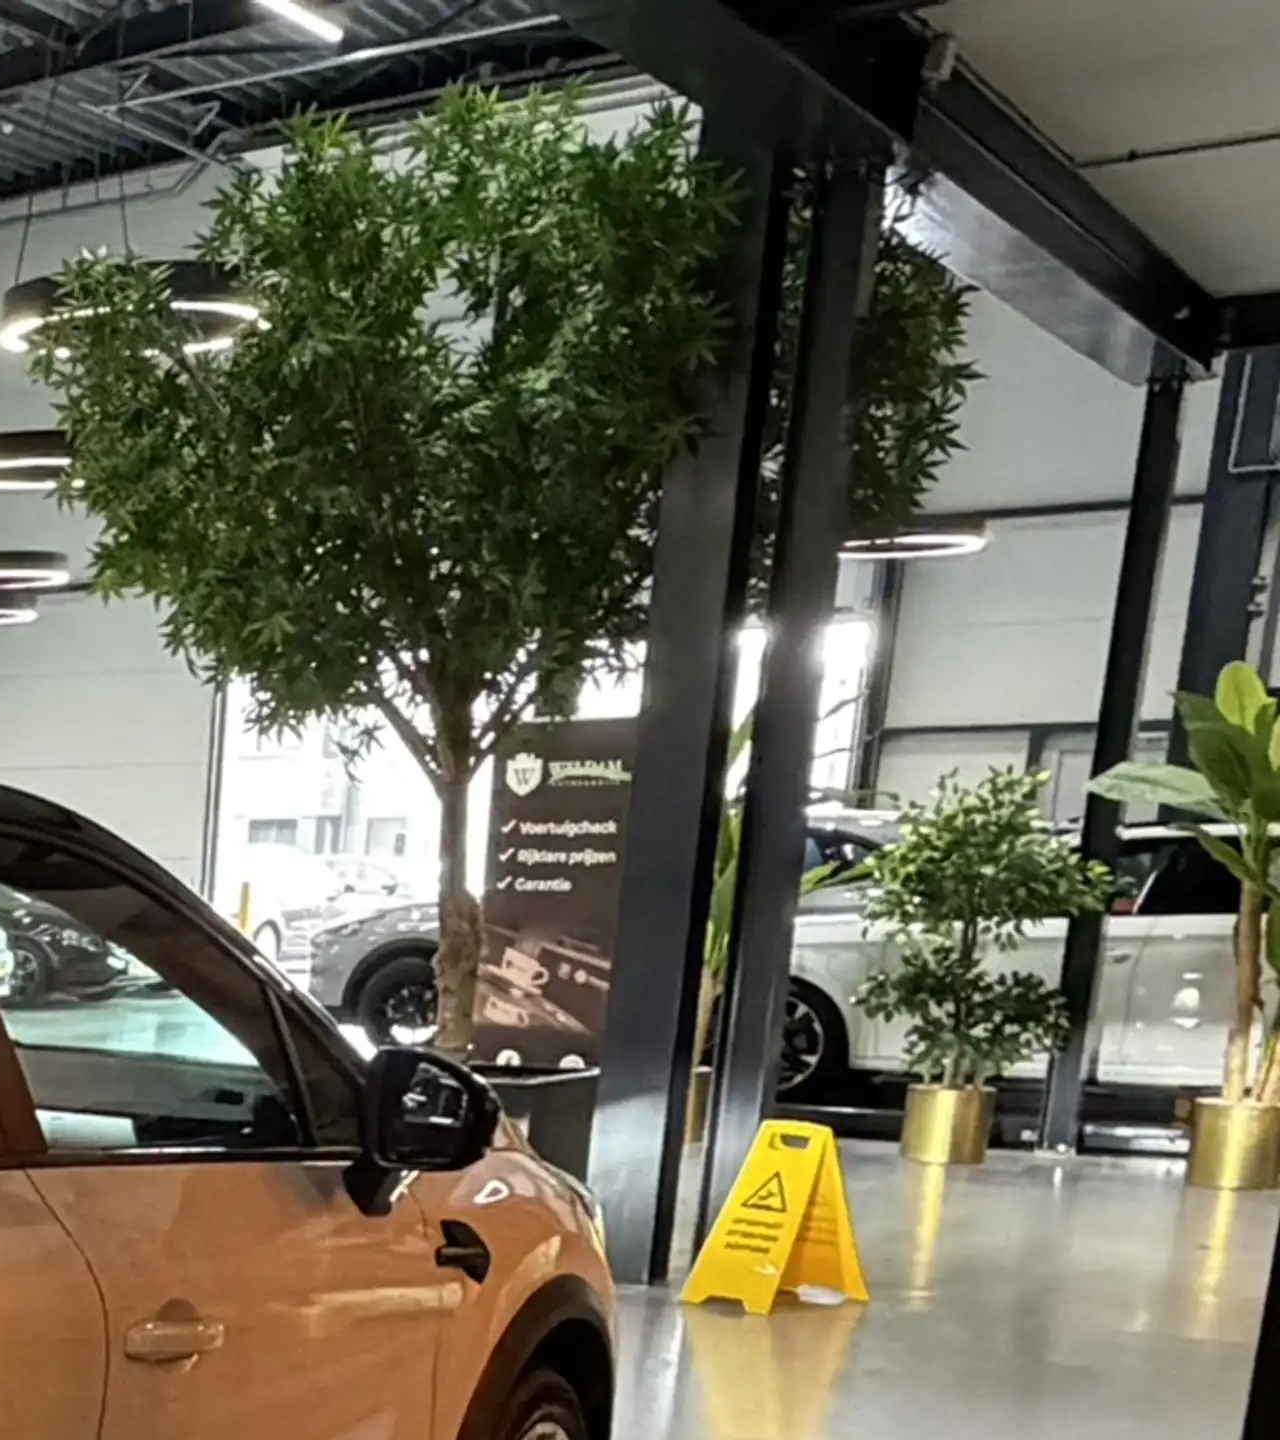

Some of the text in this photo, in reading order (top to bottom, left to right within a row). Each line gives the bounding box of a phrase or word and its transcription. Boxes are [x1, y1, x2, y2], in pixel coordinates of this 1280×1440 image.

[520, 819, 618, 838] Voertuigcheck
[568, 848, 618, 867] prijzen
[514, 877, 573, 892] Garantie
